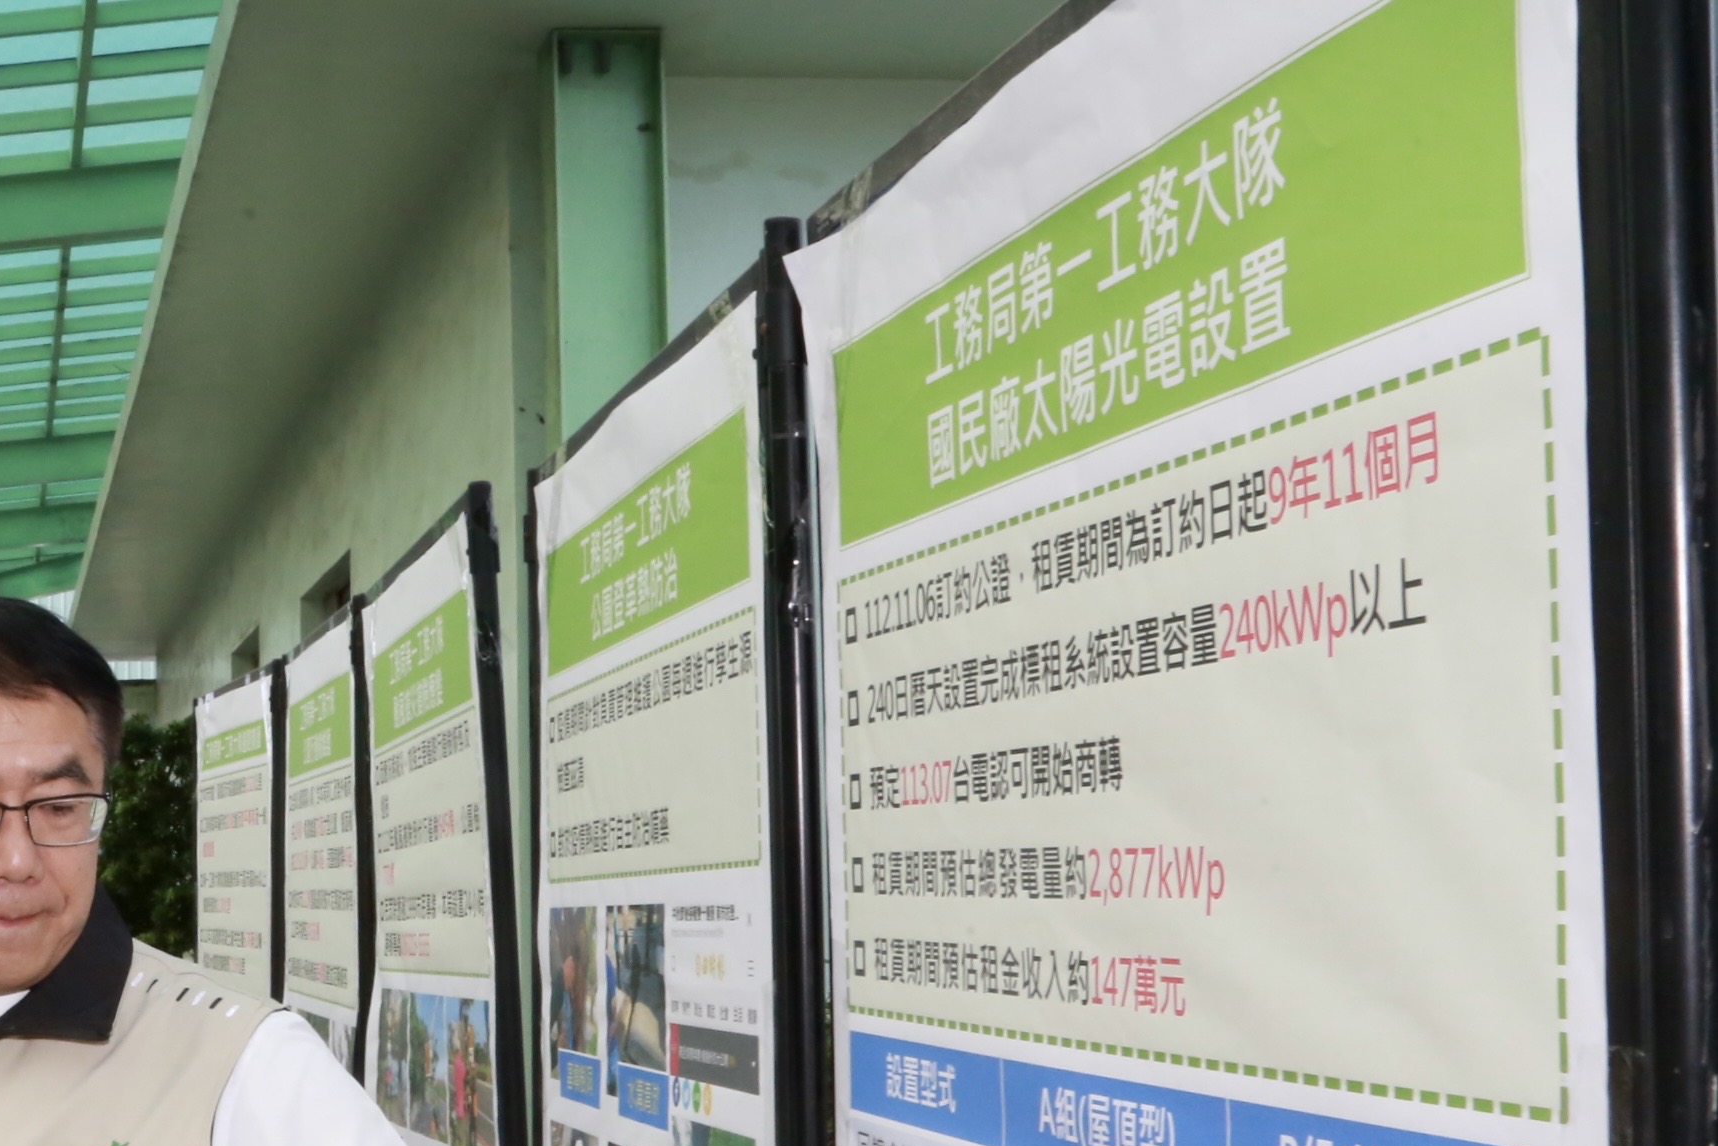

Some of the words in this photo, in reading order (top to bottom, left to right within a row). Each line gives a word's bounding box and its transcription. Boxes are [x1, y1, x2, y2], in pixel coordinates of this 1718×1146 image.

[924, 97, 1286, 386] 工務局第一工務大隊
[926, 236, 1292, 489] 國民廠太陽光電設置
[885, 1052, 957, 1114] 設置型式
